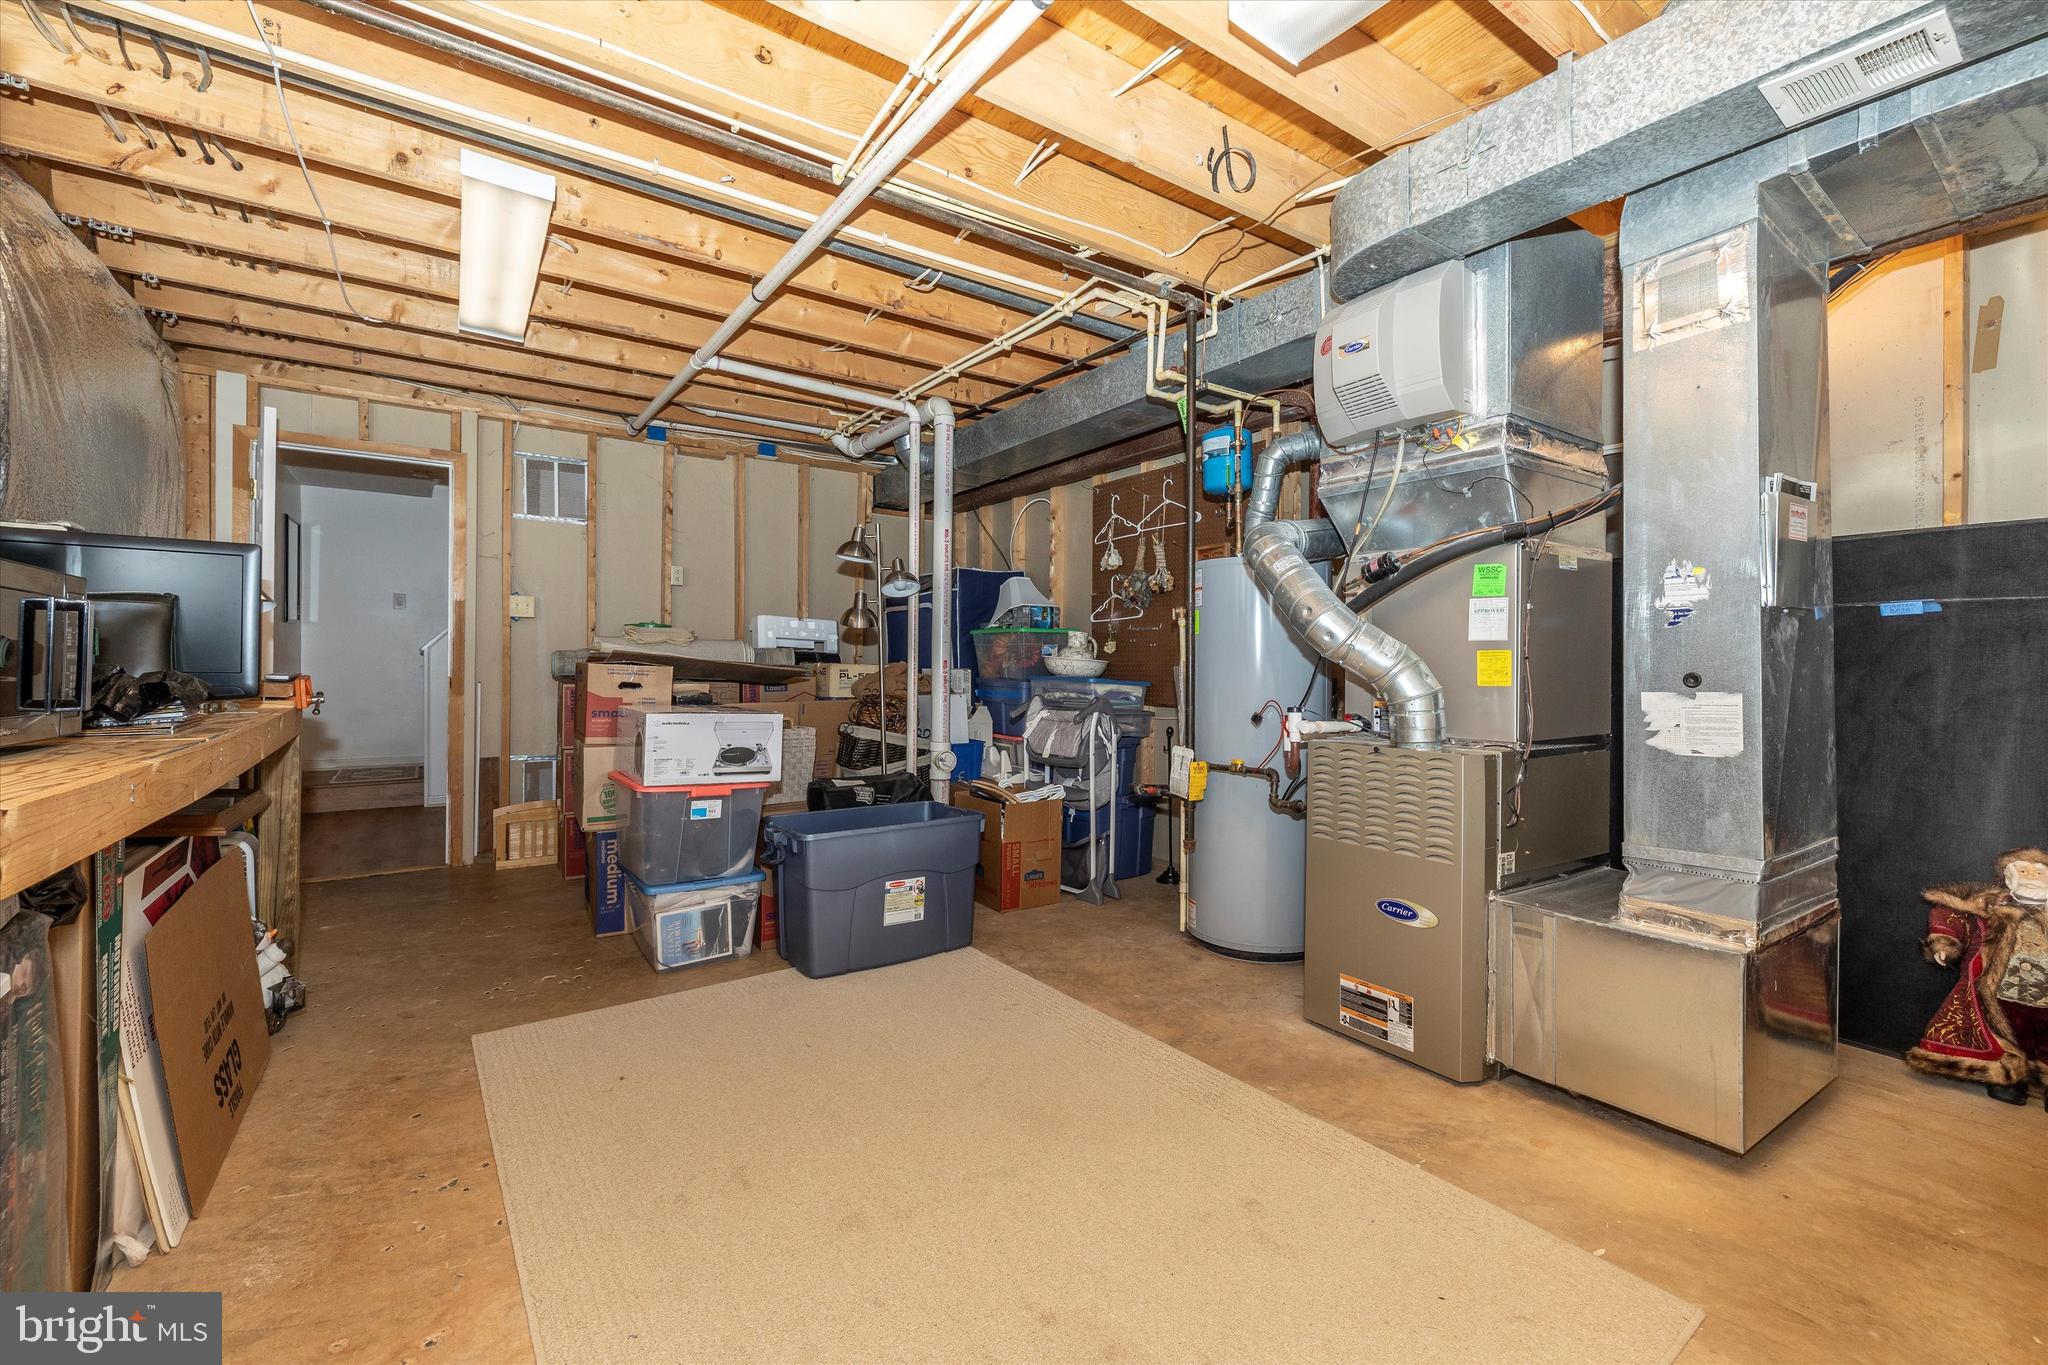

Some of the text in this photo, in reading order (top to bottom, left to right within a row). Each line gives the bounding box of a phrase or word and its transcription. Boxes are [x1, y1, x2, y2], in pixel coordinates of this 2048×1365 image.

[1478, 565, 1502, 573] WSSC
[607, 839, 622, 904] medium
[1012, 843, 1020, 877] SMALL
[1381, 902, 1413, 917] Carrier
[113, 933, 121, 1032] MOTORIZED
[126, 961, 146, 1053] Animal Production
[138, 996, 147, 1037] America
[125, 1030, 136, 1069] Putting
[131, 1011, 143, 1059] Industrial
[214, 1038, 242, 1108] GLASS
